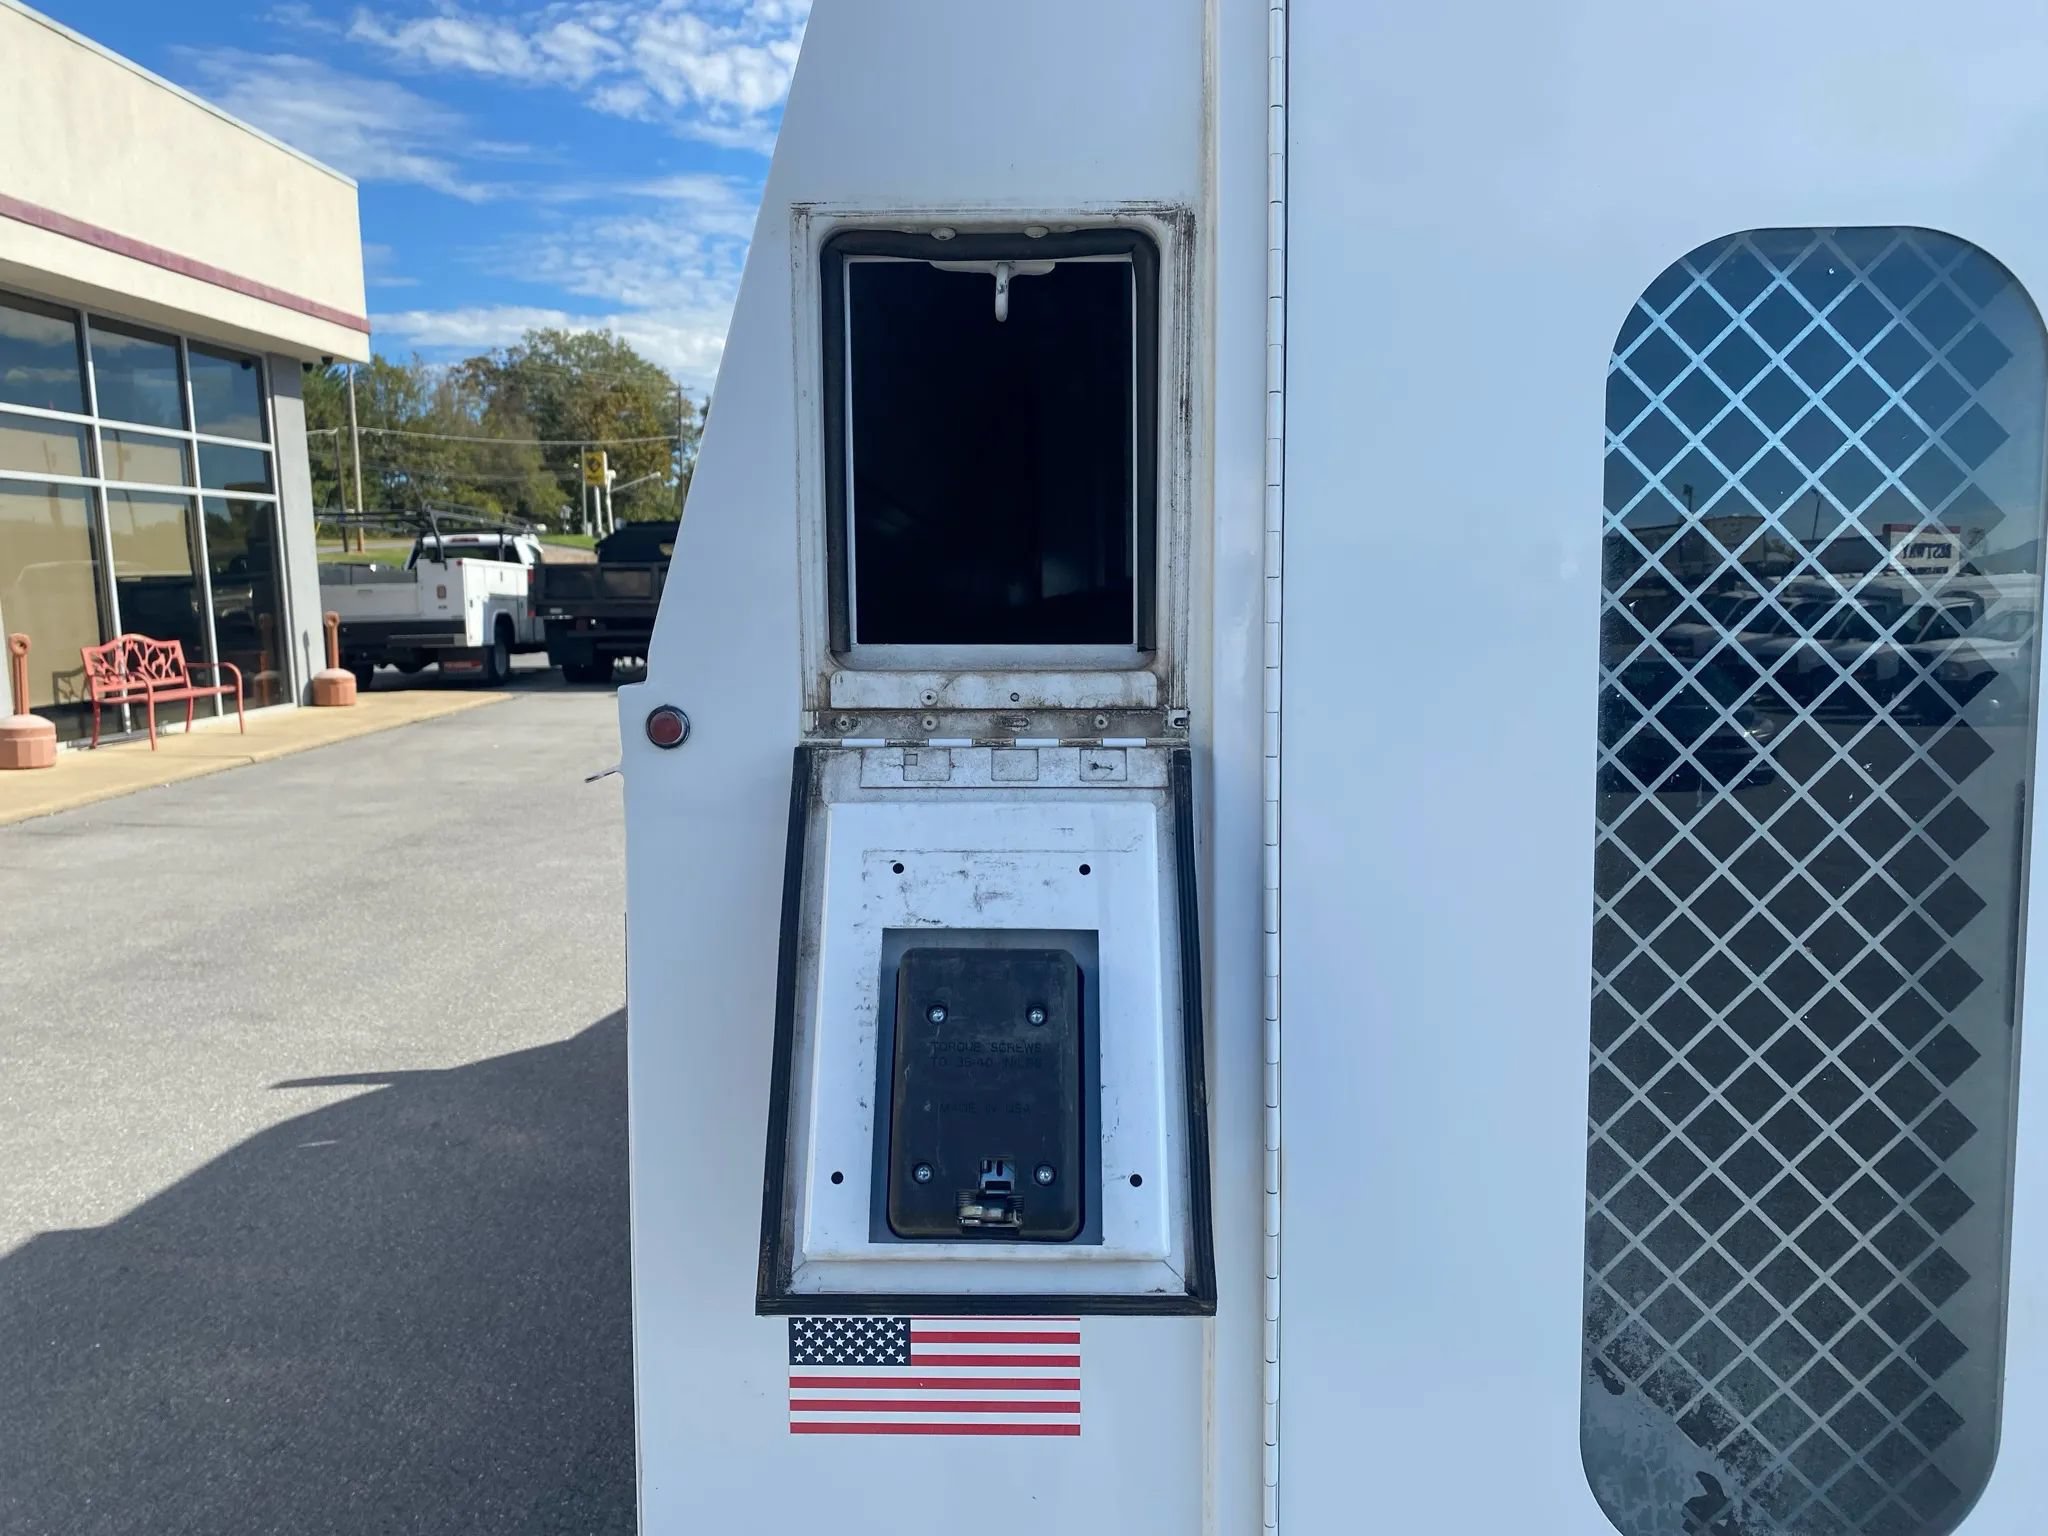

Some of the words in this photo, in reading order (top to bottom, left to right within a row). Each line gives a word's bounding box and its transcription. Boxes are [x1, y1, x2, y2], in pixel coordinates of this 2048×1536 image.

[930, 1041, 982, 1053] TORQUE
[990, 1041, 1042, 1054] SCREWS
[929, 1056, 947, 1068] TO
[939, 1102, 977, 1114] MADE
